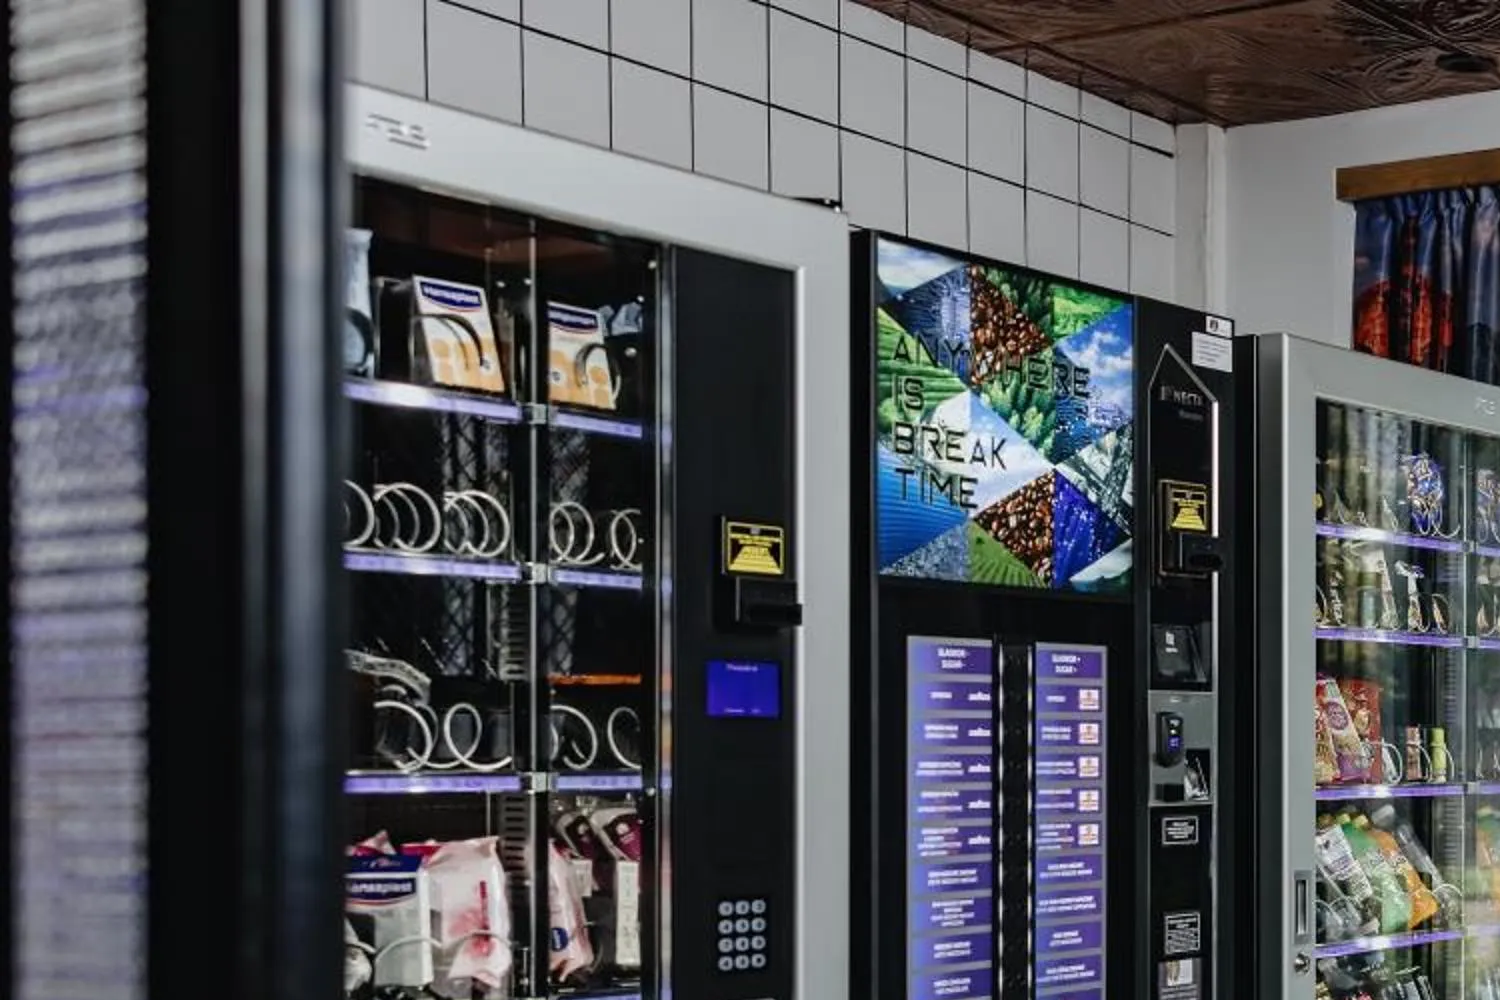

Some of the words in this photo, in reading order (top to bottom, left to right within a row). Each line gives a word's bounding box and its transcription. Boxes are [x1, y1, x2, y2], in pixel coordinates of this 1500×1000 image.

[893, 374, 924, 411] IS
[894, 421, 1007, 471] BREAK
[894, 464, 979, 509] TIME
